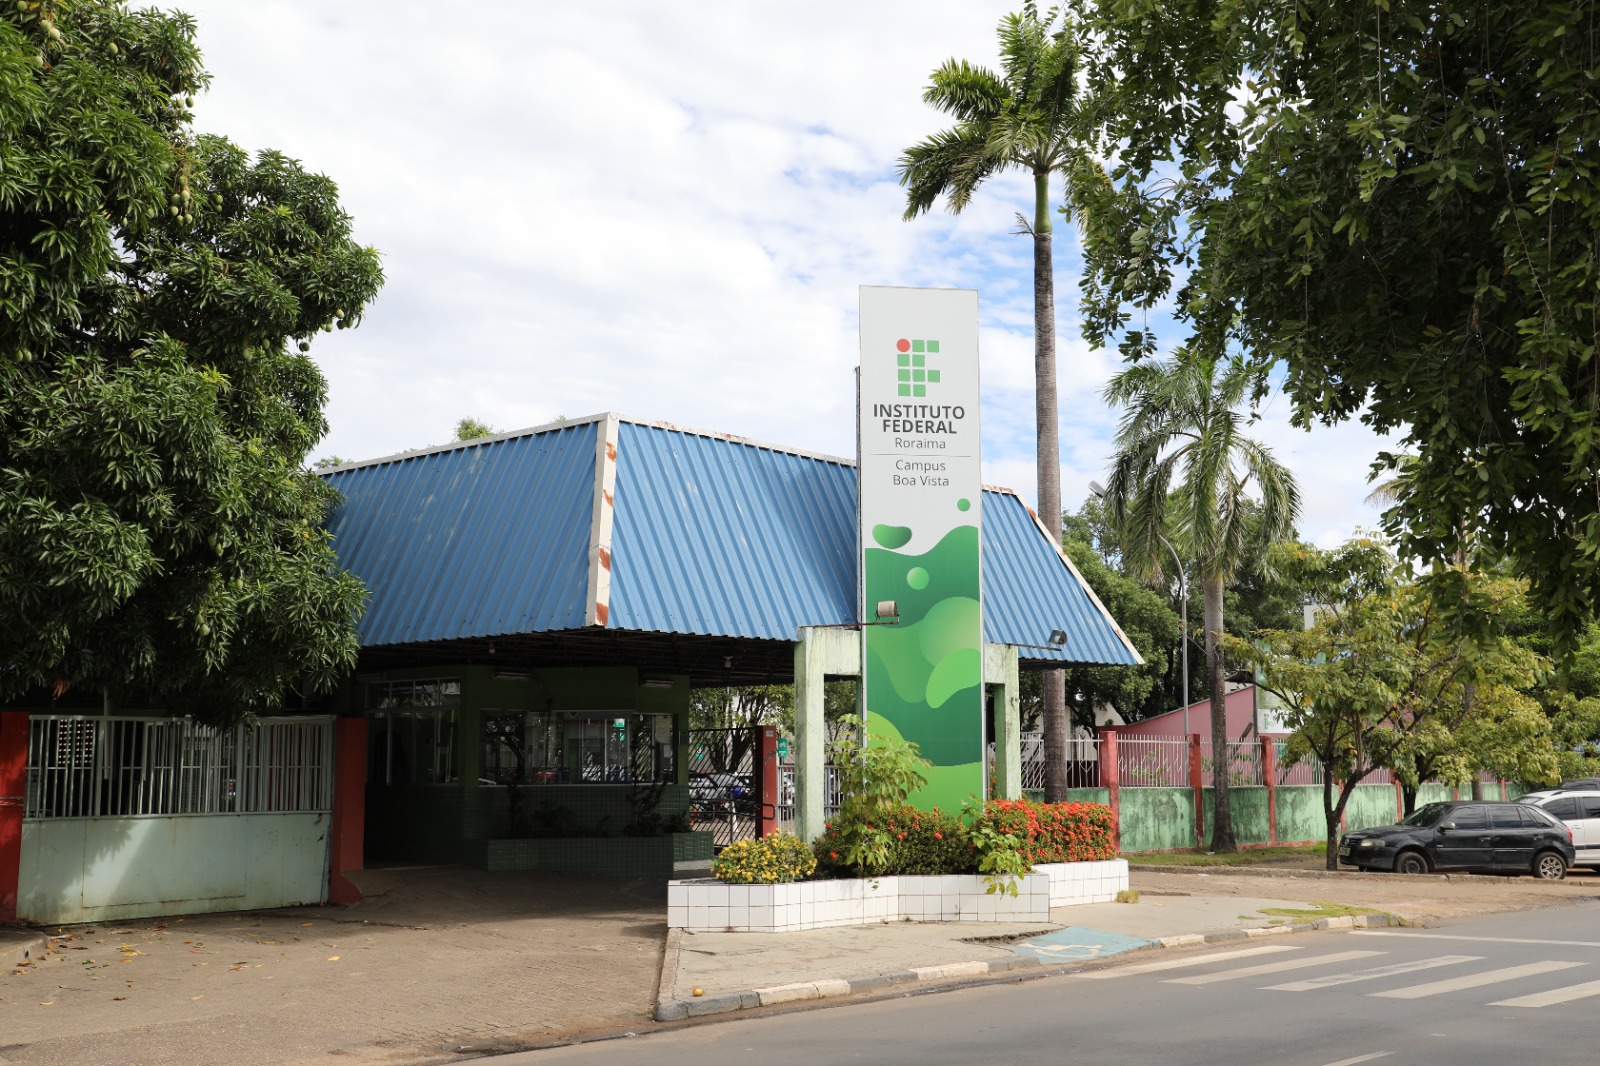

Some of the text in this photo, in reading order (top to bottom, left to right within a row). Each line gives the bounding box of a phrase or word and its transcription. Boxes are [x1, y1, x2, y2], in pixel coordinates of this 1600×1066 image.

[873, 404, 965, 419] INSTITUTO
[883, 419, 957, 434] FEDERAL
[895, 437, 946, 449] Roraima
[895, 459, 946, 473] Campus
[893, 474, 950, 487] Boa Vista
